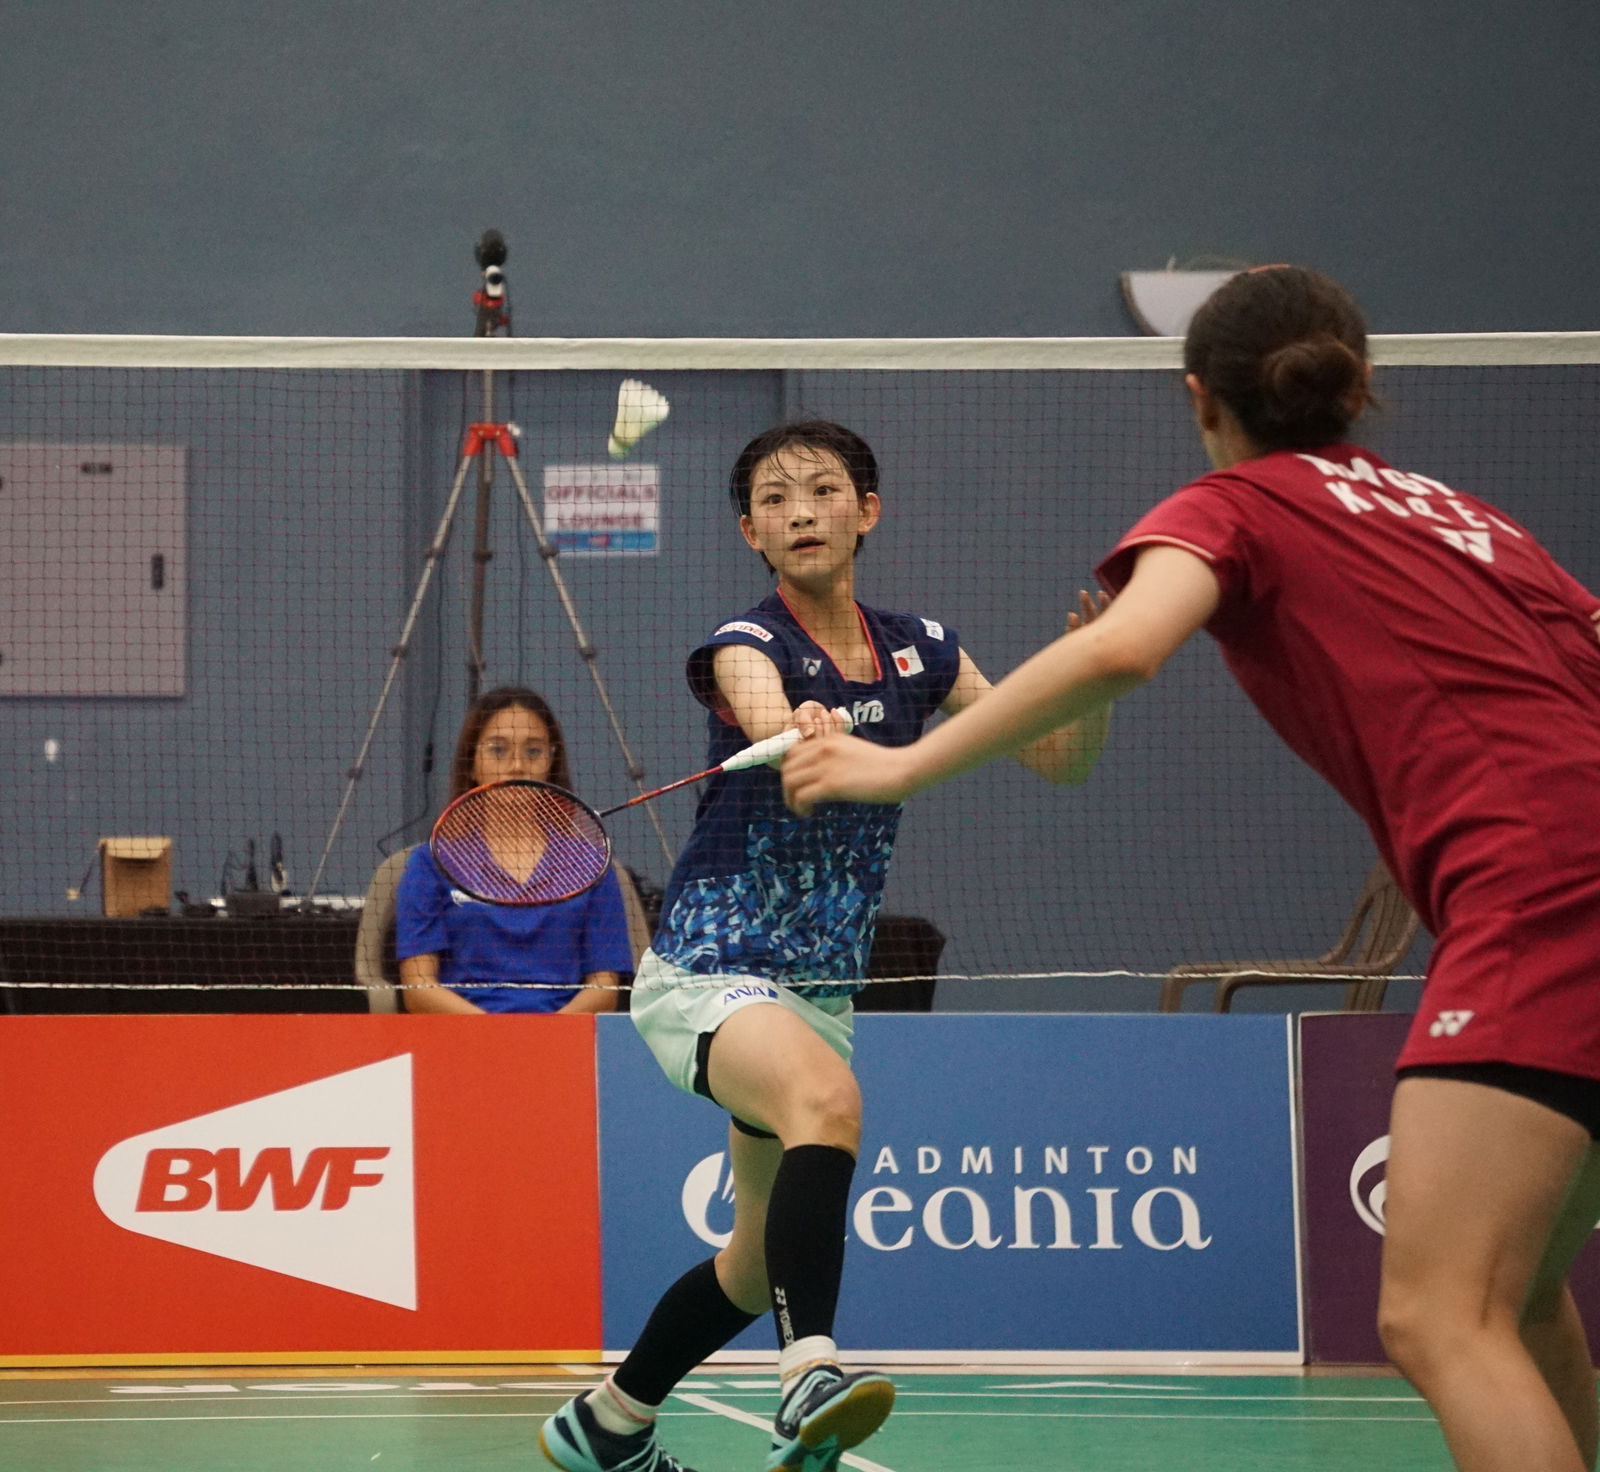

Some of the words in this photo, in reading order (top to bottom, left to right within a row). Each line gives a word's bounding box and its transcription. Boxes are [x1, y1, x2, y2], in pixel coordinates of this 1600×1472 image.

[723, 986, 766, 1005] ANA
[135, 1147, 391, 1212] BWF
[873, 1146, 1197, 1174] ADMINTON
[681, 1152, 1212, 1250] Oeania
